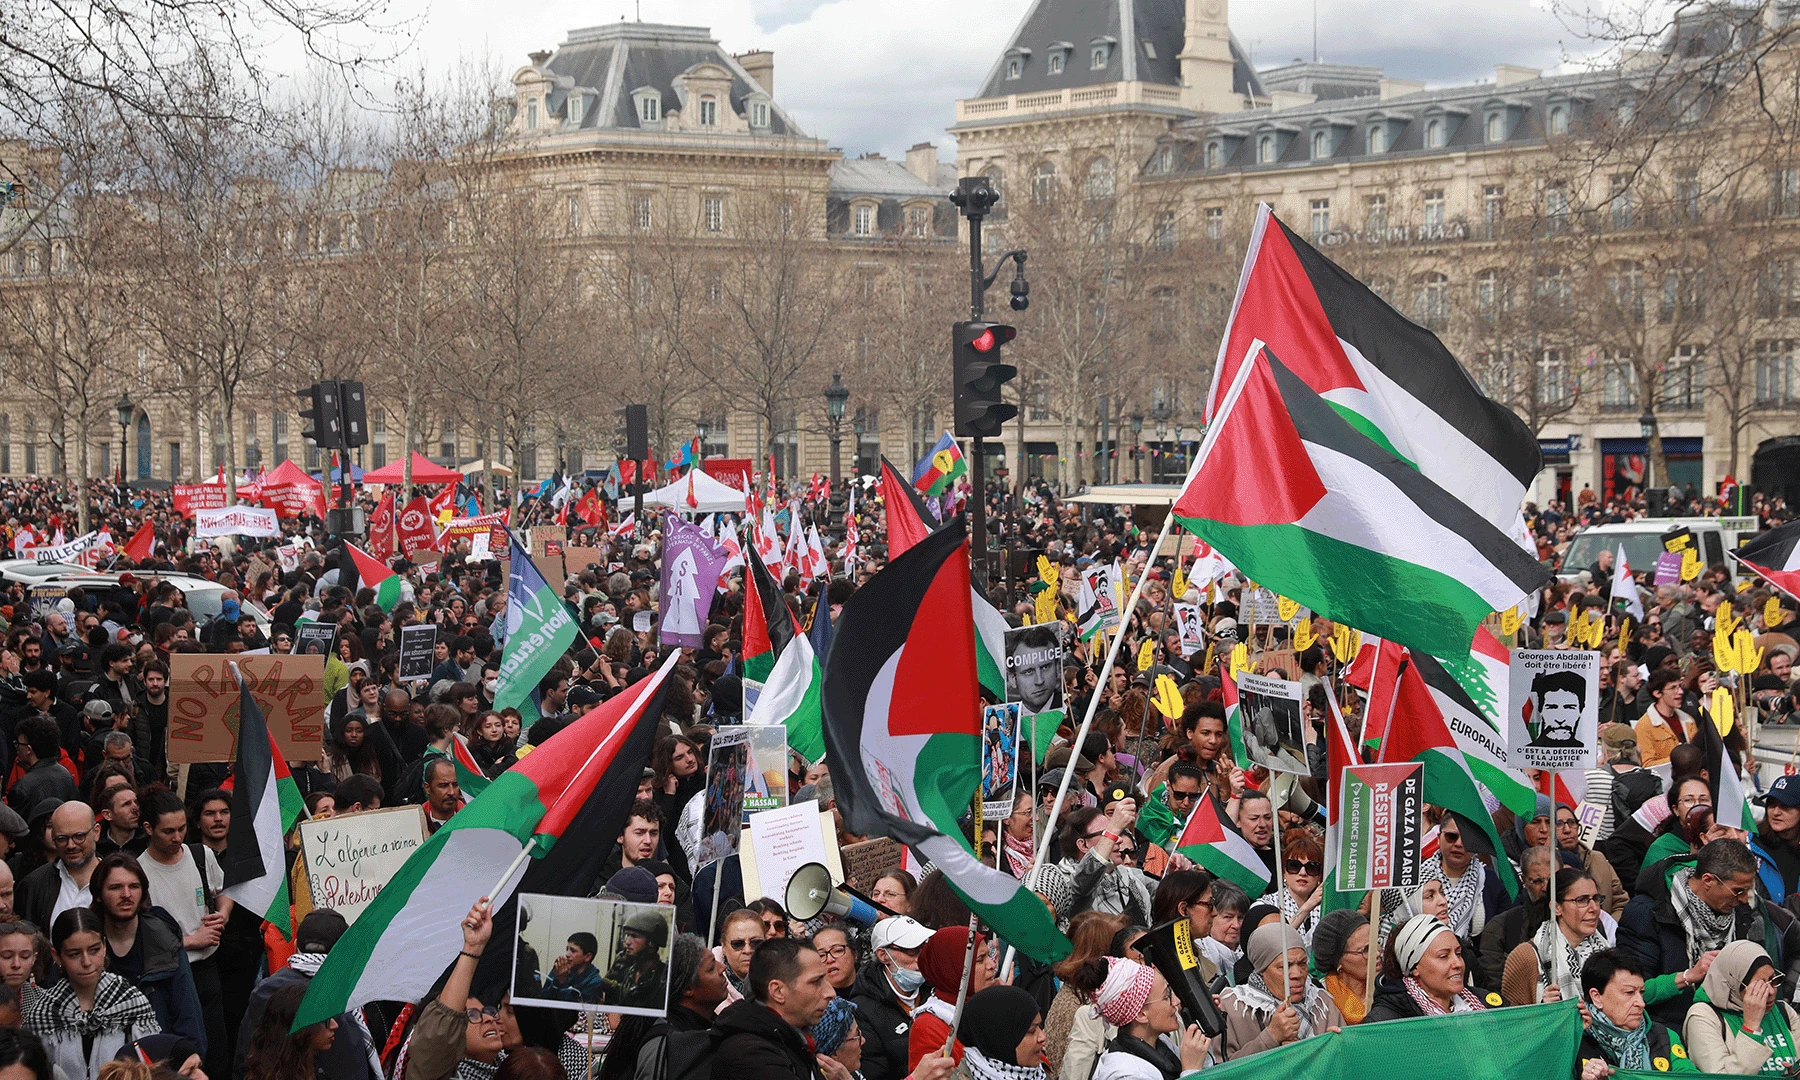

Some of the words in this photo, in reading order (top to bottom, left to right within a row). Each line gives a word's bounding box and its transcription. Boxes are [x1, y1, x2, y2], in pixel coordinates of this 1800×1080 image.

[1418, 221, 1464, 240] PLAZA
[37, 534, 97, 561] COLLECTIF
[1006, 646, 1061, 668] COMPLICE
[1518, 652, 1554, 661] Georges
[1556, 652, 1594, 661] Abdallah
[1525, 661, 1542, 669] doit
[1543, 661, 1561, 669] être
[1562, 661, 1586, 669] libéré
[191, 657, 324, 742] PASARAN
[171, 697, 208, 742] NO
[1552, 747, 1590, 755] DÉCISION
[1531, 760, 1574, 769] FRANÇAISE
[1404, 778, 1416, 795] DE
[749, 799, 778, 807] HASSAN
[1349, 796, 1360, 834] URGENCE
[1403, 796, 1415, 835] GAZA
[1374, 782, 1392, 875] RÉSISTANCE
[380, 845, 389, 853] a
[1403, 837, 1414, 846] A
[1347, 836, 1359, 889] PALESTINE
[1401, 849, 1414, 886] PARIS
[1177, 935, 1185, 955] GAZA
[1180, 923, 1189, 953] SECOURS
[1186, 954, 1193, 964] AU
